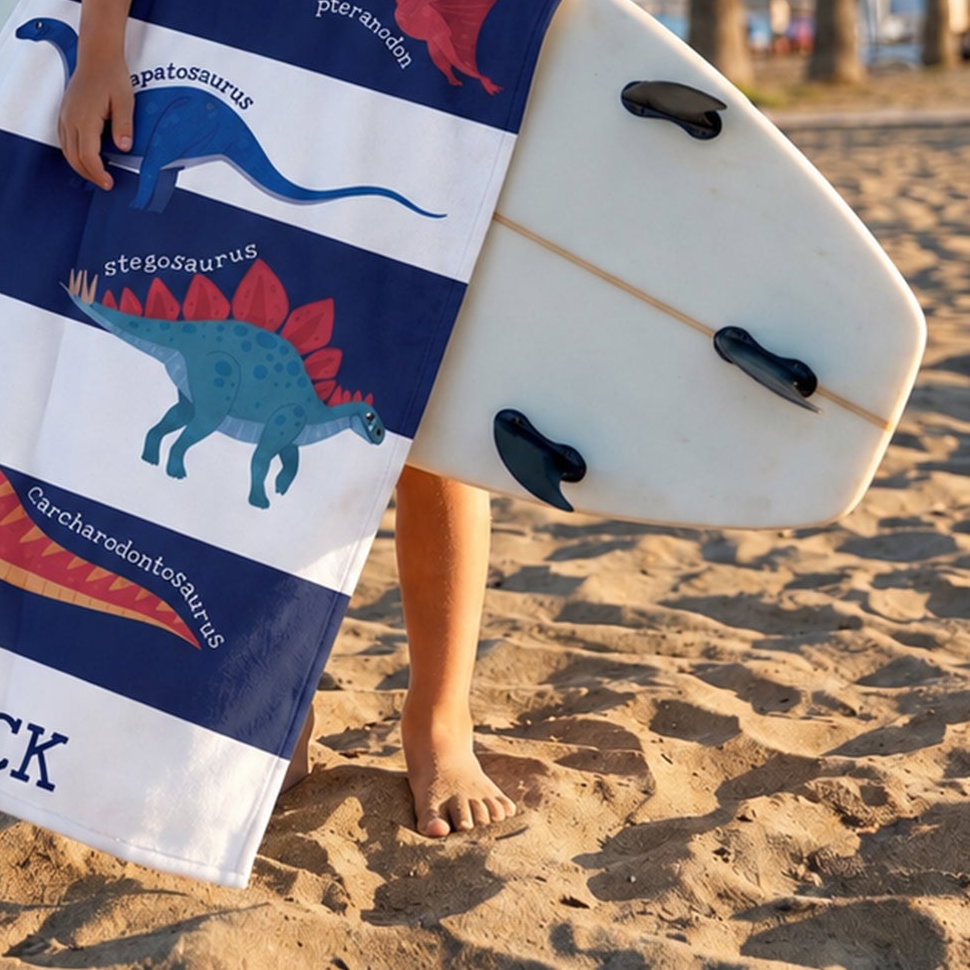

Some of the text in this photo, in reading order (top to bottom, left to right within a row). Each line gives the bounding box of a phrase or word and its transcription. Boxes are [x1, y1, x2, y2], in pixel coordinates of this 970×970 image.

[130, 62, 254, 110] apatosaurus
[104, 243, 258, 276] stegosaurus
[27, 486, 225, 649] Carcharodontosaurus
